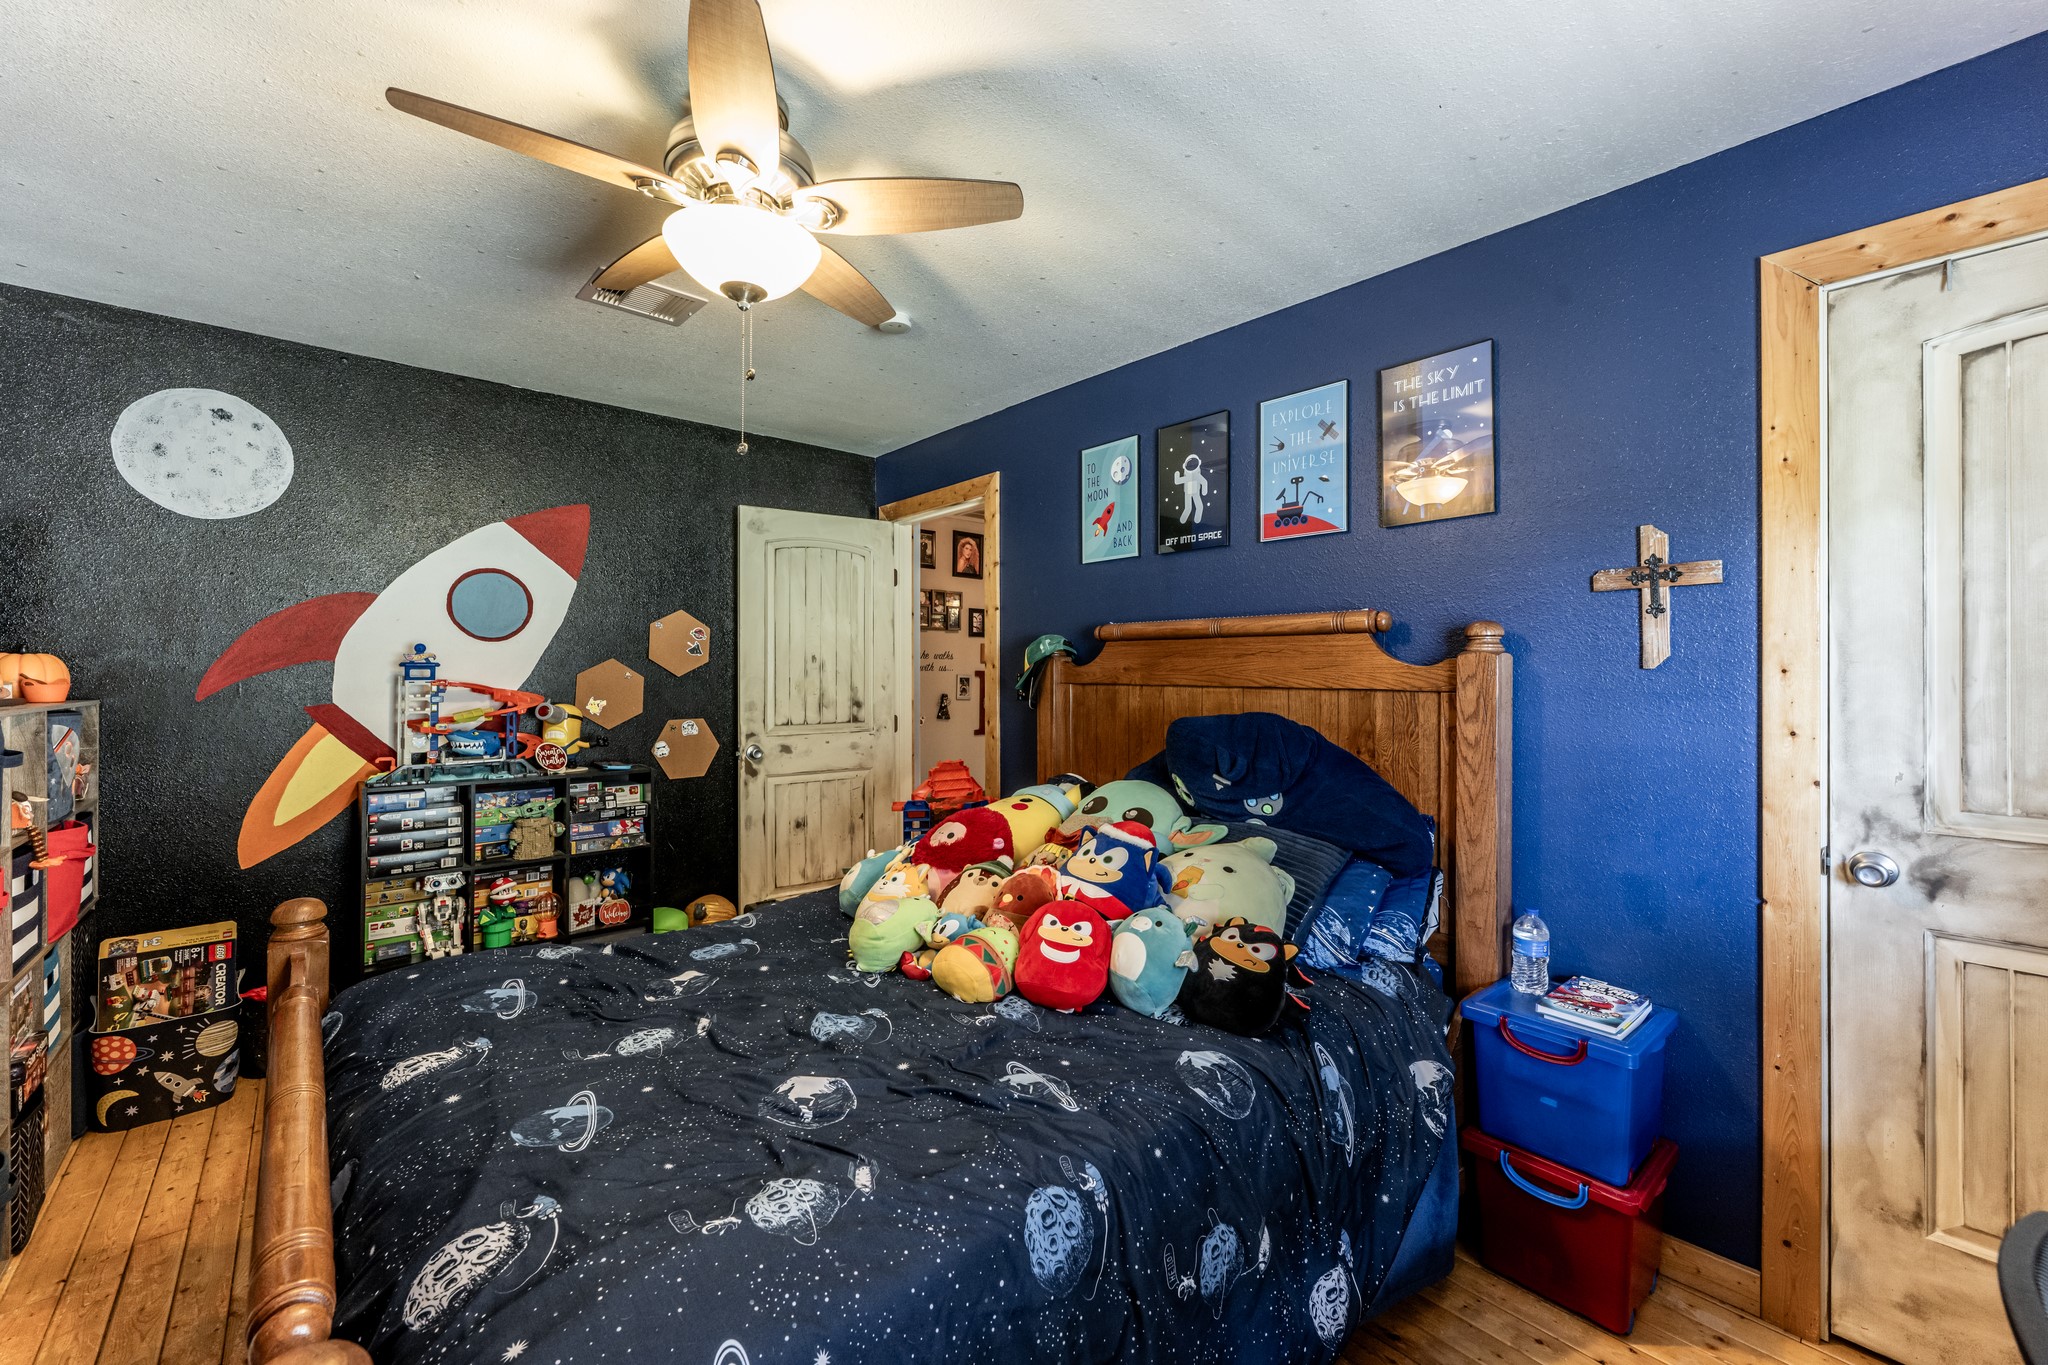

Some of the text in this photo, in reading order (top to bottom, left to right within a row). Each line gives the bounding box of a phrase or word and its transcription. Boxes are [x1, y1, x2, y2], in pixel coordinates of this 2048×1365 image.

[1394, 365, 1460, 394] THE SKY
[1394, 379, 1485, 413] IS THE LIMIT
[1273, 400, 1334, 427] EXPLORE
[1290, 430, 1313, 447] THE
[1088, 463, 1096, 474] TO
[1274, 450, 1335, 474] UNIVERSE
[1088, 478, 1100, 488] THE
[1088, 488, 1109, 502] MOON
[1117, 521, 1132, 533] AND
[1114, 536, 1132, 548] BACK
[1166, 531, 1222, 546] OFF INTO SPACE
[934, 651, 954, 660] walks
[191, 947, 200, 959] 8+
[216, 945, 226, 1006] LEGO CREATOR
